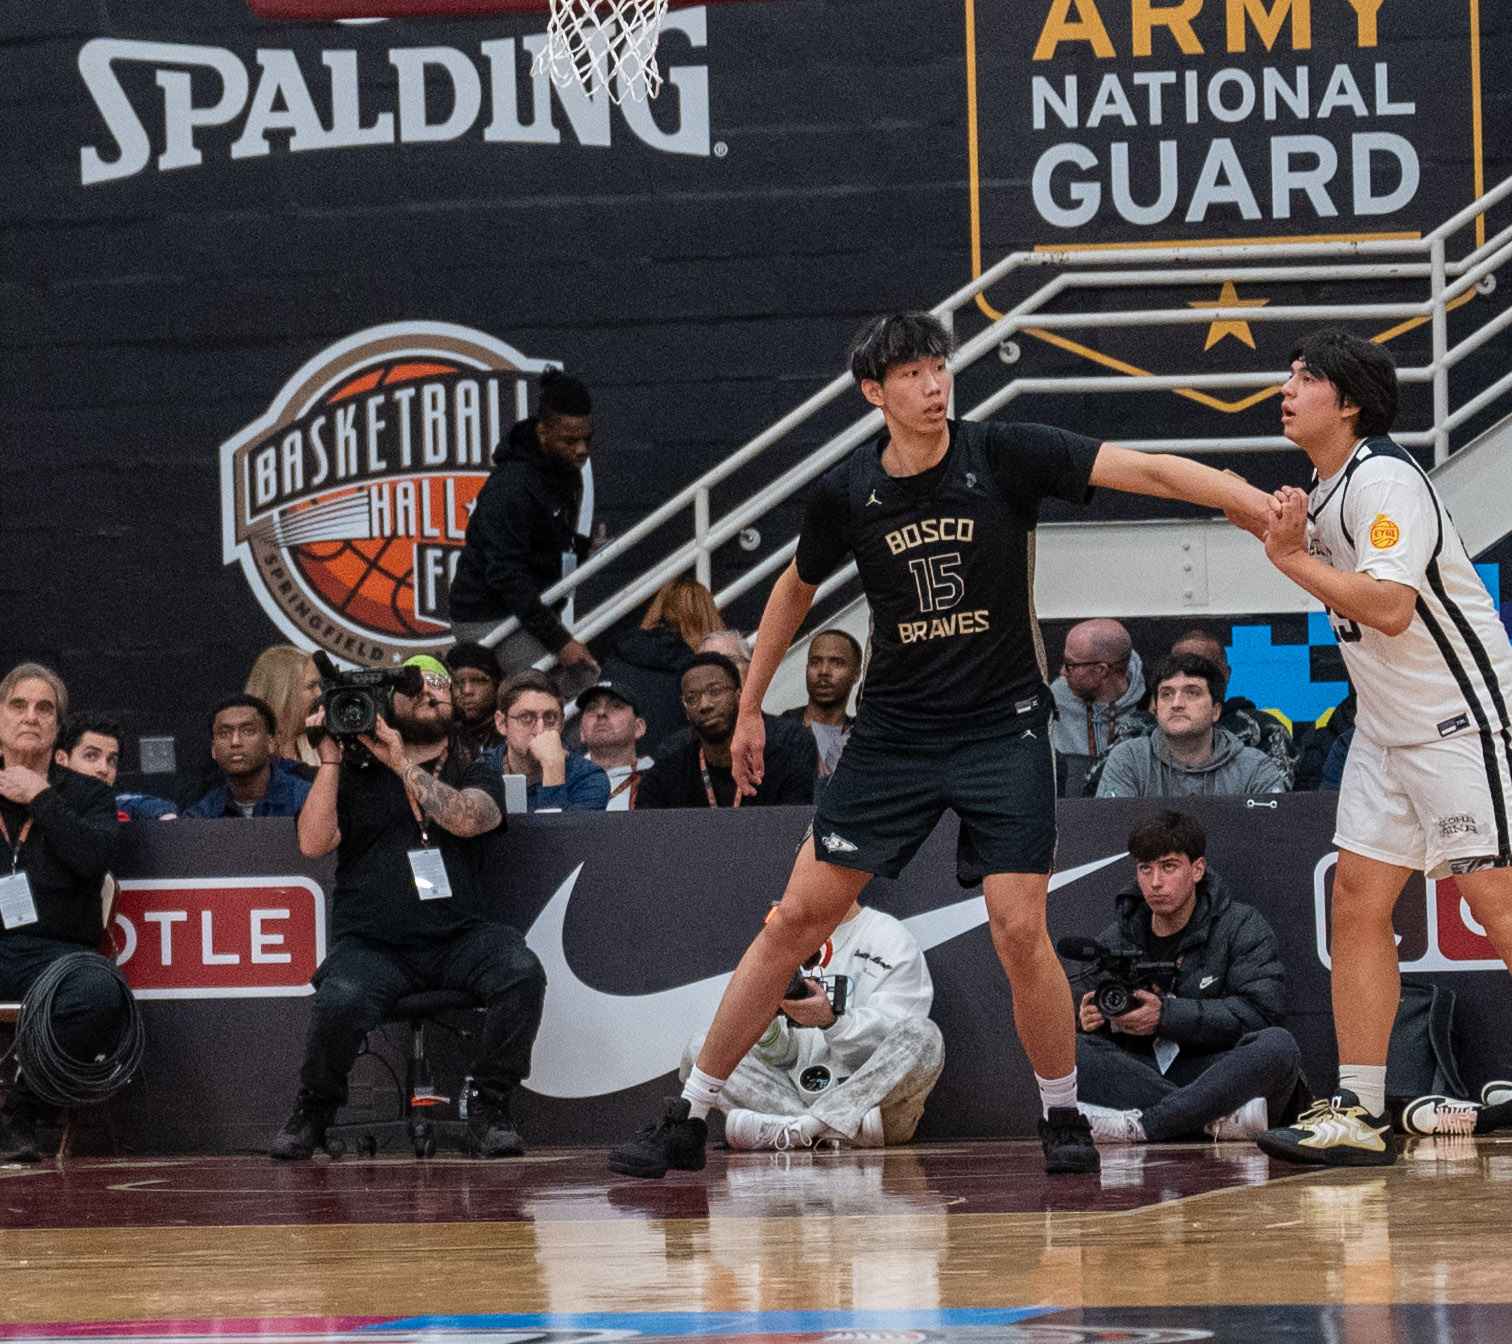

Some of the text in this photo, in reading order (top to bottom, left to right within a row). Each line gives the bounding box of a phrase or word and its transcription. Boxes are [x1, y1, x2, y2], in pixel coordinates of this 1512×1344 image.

[79, 5, 710, 187] SPALDING
[1032, 61, 1417, 131] NATIONAL
[1031, 131, 1421, 228] GUARD
[369, 479, 466, 539] HALL
[885, 518, 975, 556] BOSCO
[262, 554, 385, 662] SPRINGFIELD
[908, 552, 965, 613] 15
[897, 609, 990, 645] BRAVES
